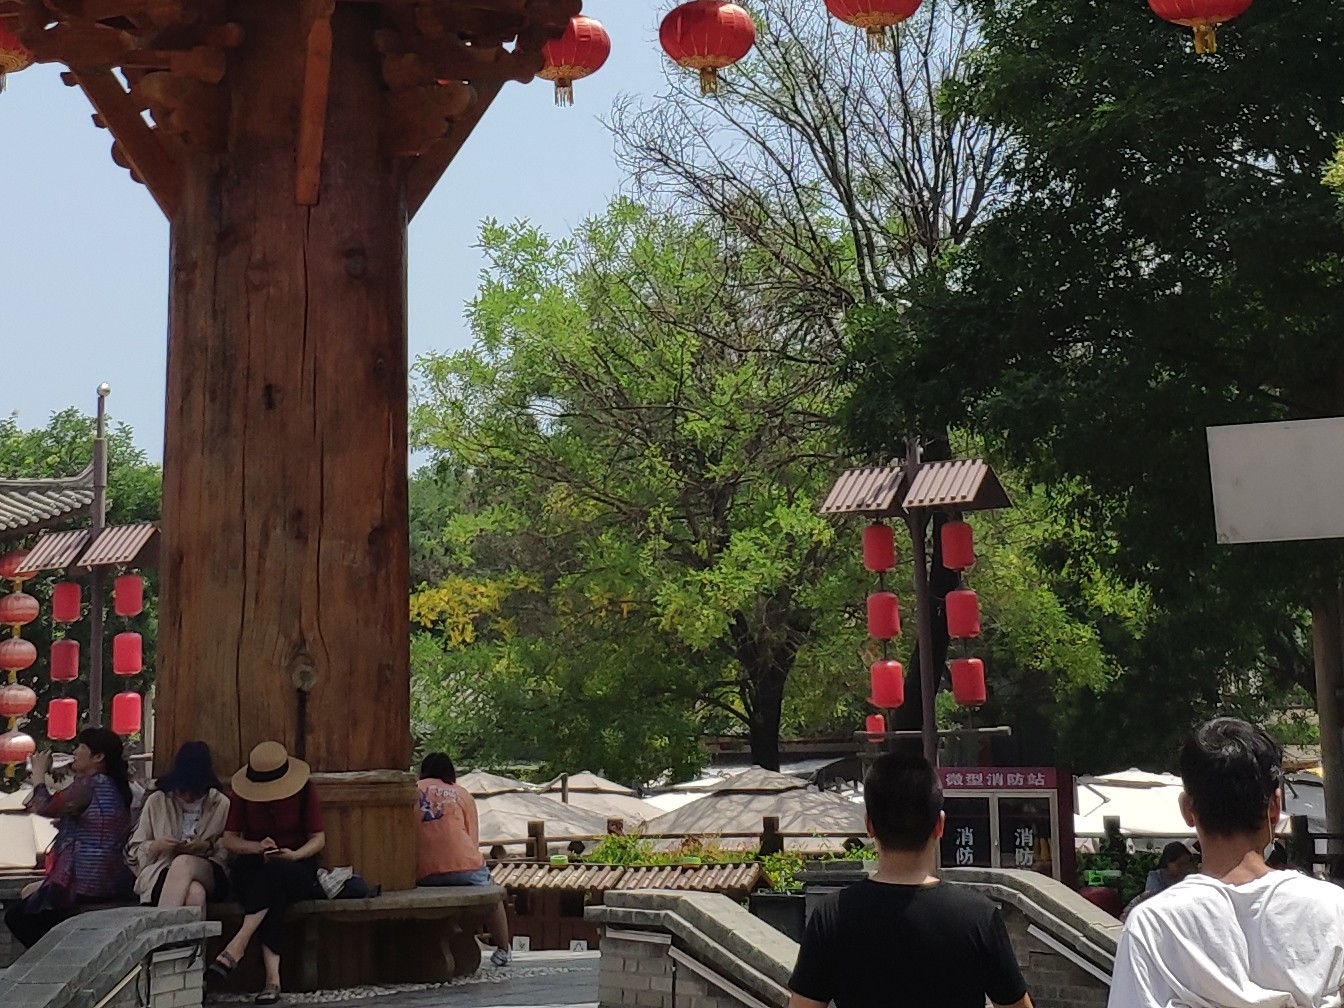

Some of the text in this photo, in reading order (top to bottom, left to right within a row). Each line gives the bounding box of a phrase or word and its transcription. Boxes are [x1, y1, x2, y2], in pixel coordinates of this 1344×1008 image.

[945, 772, 1046, 787] 微型消防站
[955, 826, 974, 866] 消防
